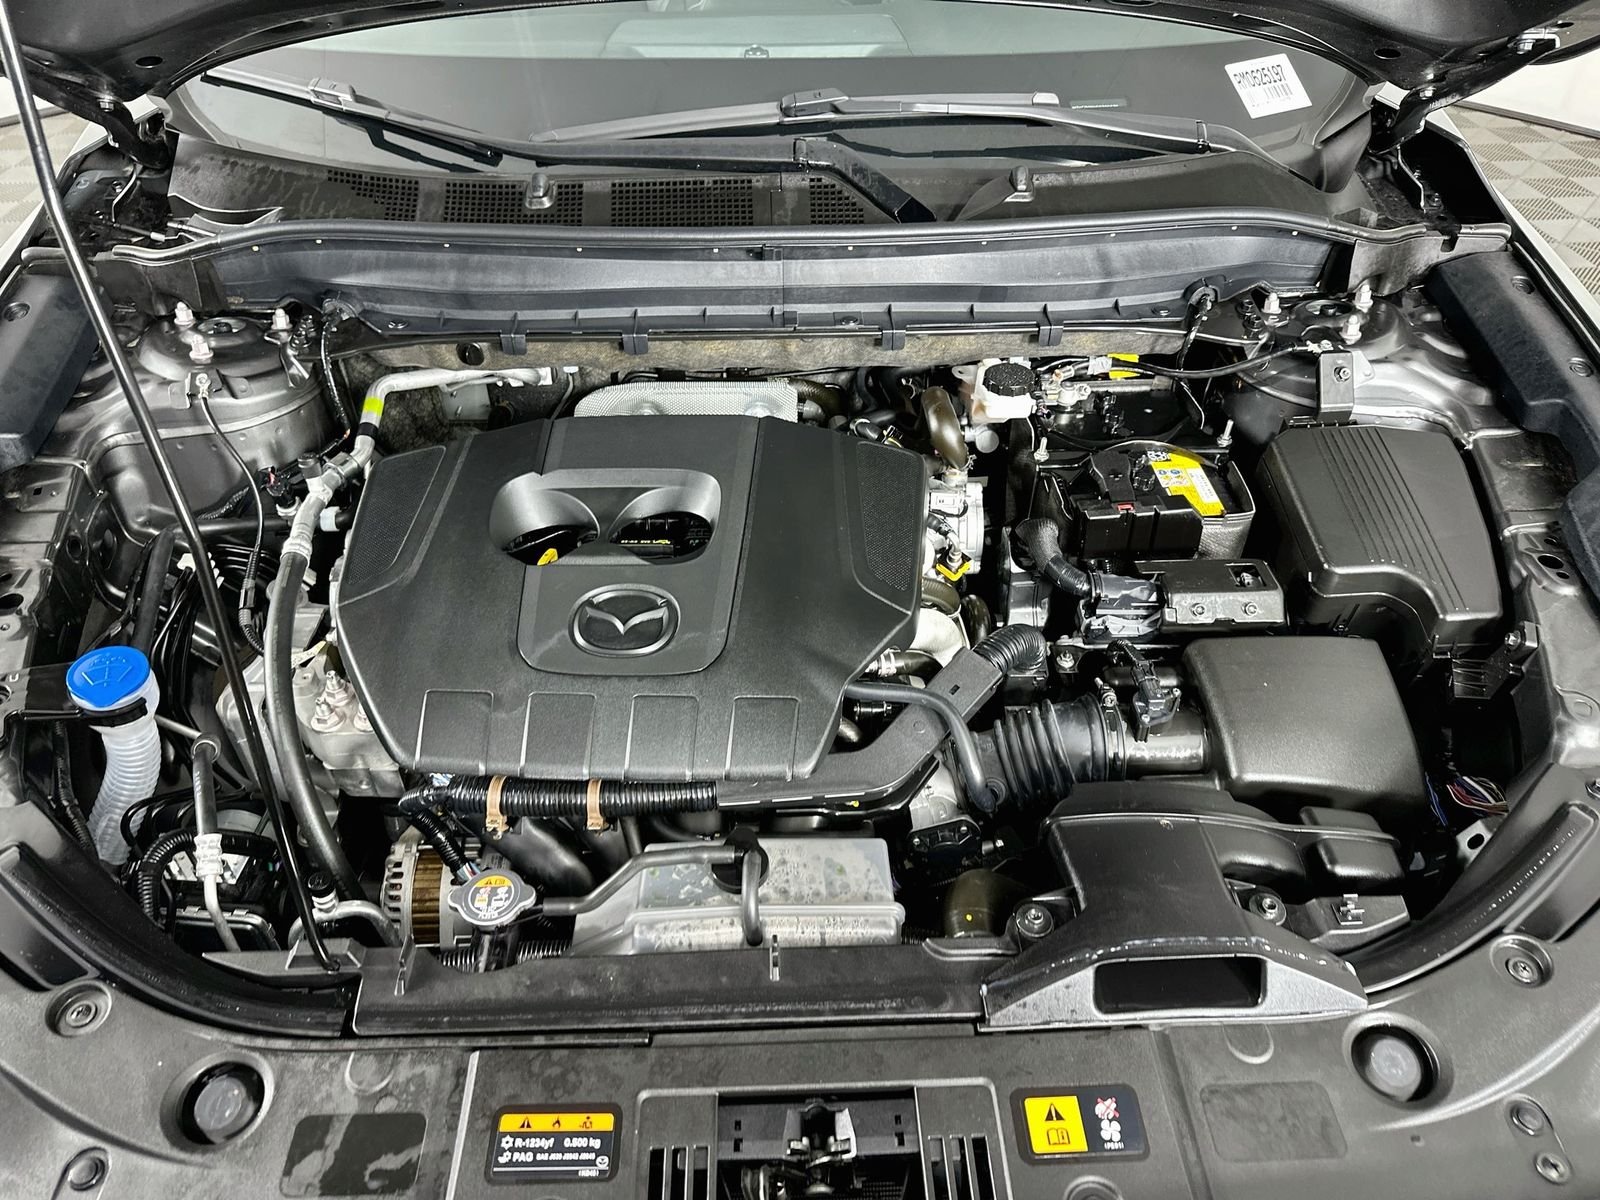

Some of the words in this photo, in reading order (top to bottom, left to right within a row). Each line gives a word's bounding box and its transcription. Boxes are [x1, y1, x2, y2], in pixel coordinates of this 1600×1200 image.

[514, 1137, 555, 1150] R-1234yf
[589, 1137, 602, 1149] kg
[512, 1151, 534, 1163] PAG
